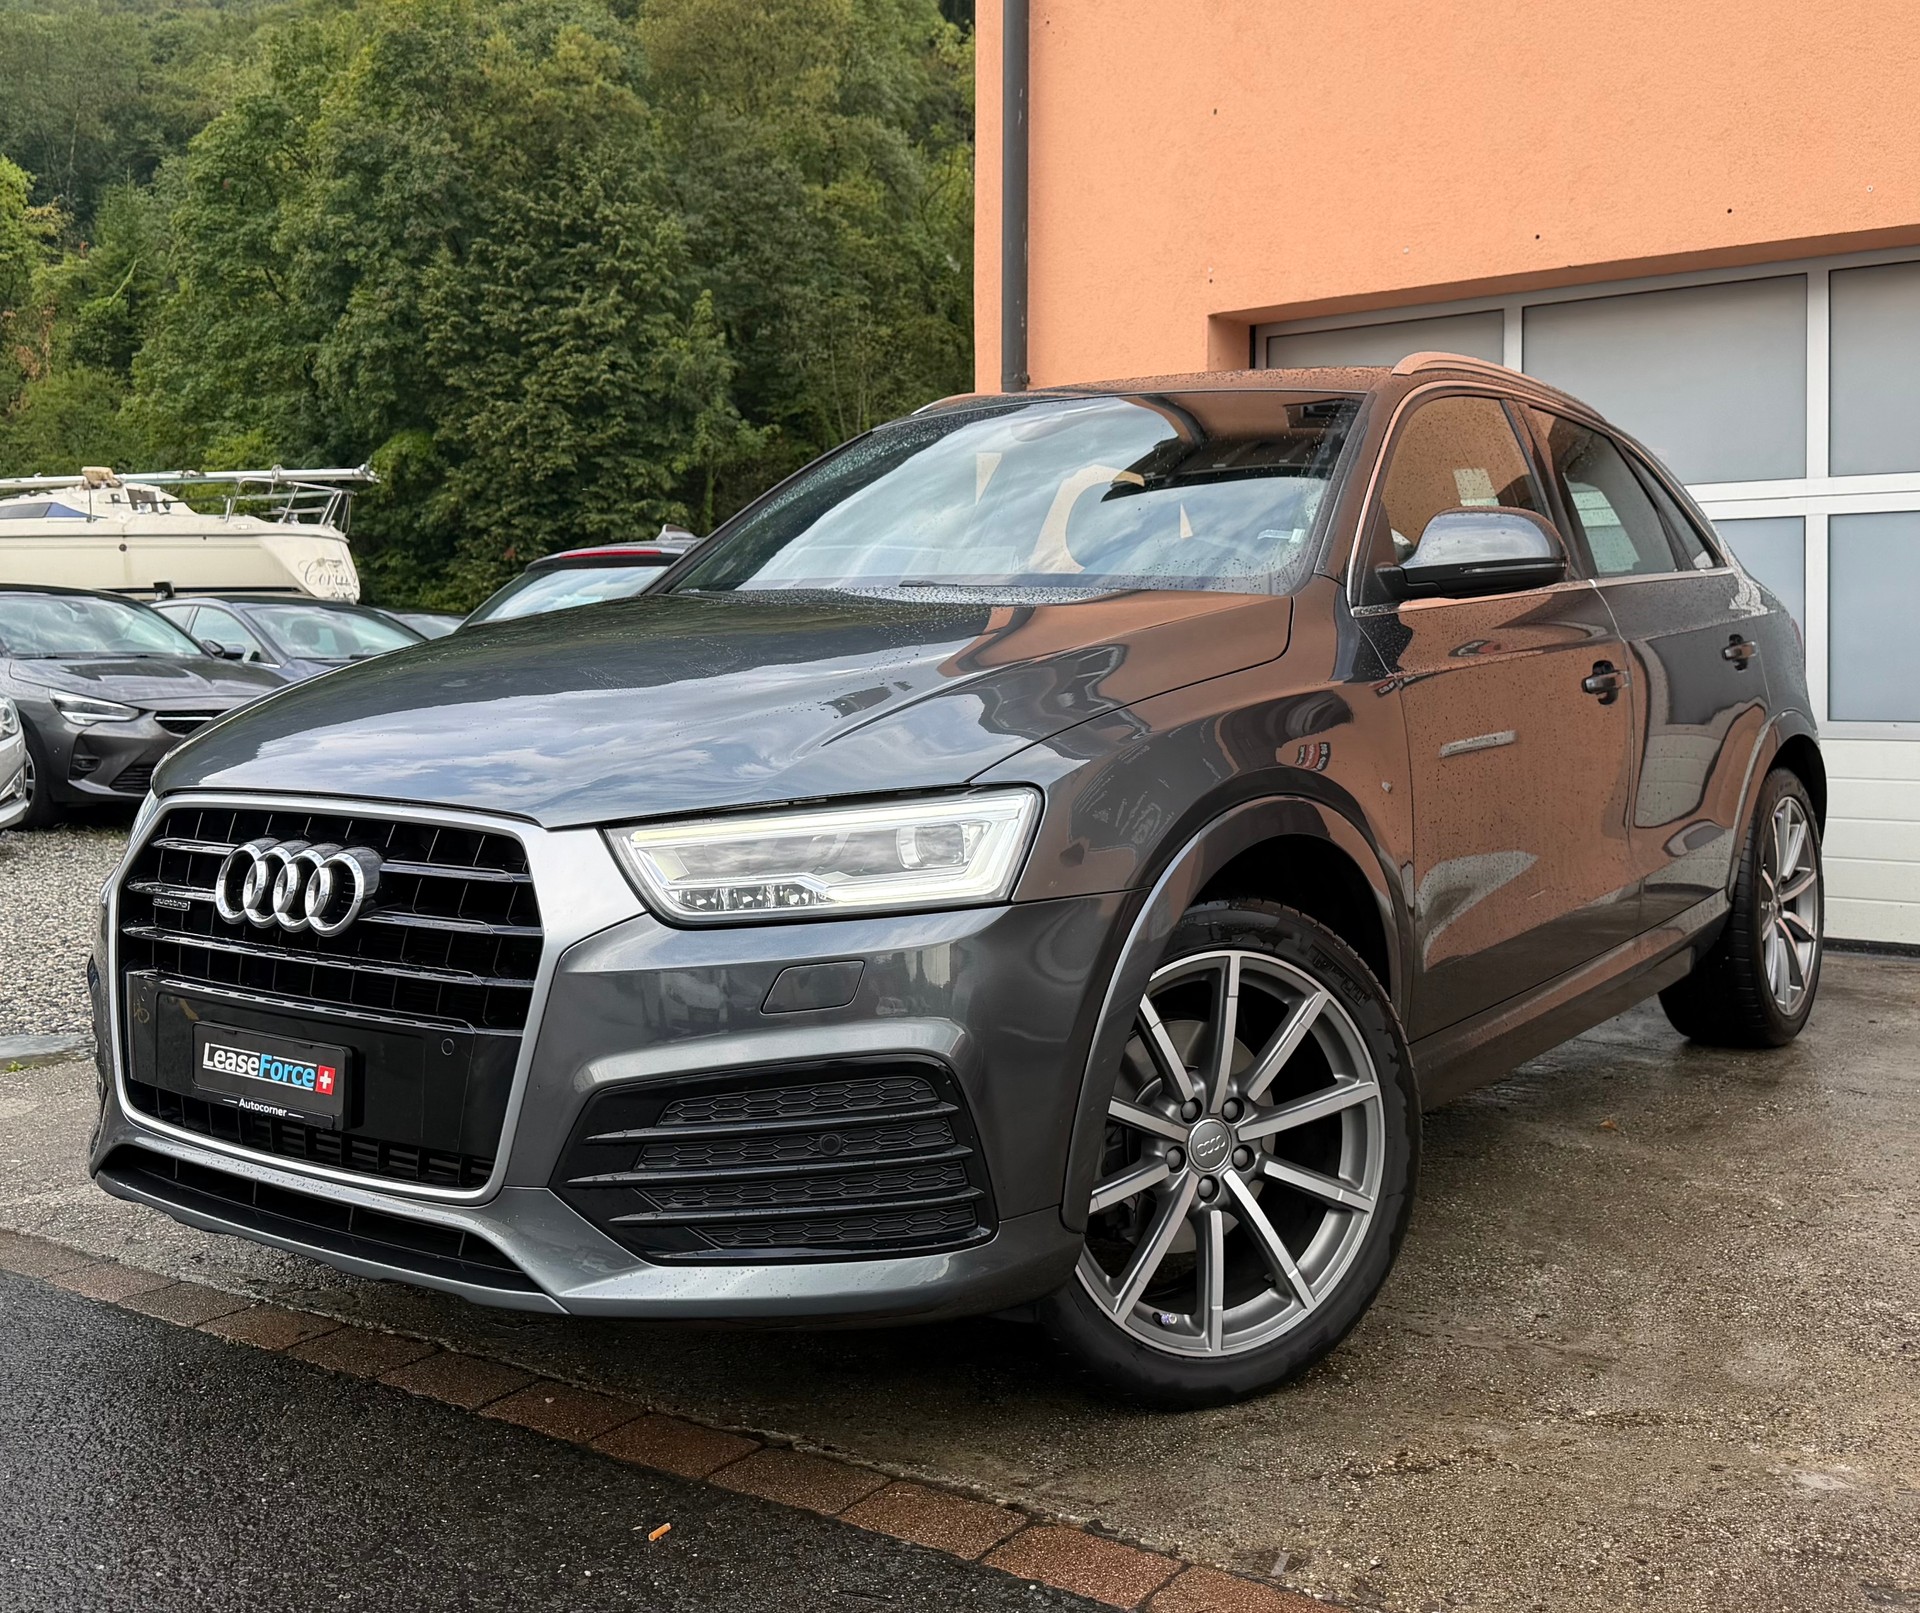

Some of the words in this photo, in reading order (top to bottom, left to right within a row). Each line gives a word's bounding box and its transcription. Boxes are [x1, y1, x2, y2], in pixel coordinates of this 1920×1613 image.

[153, 898, 188, 909] quattro
[203, 1042, 316, 1088] LeaseForce
[238, 1098, 287, 1117] Autocorner
